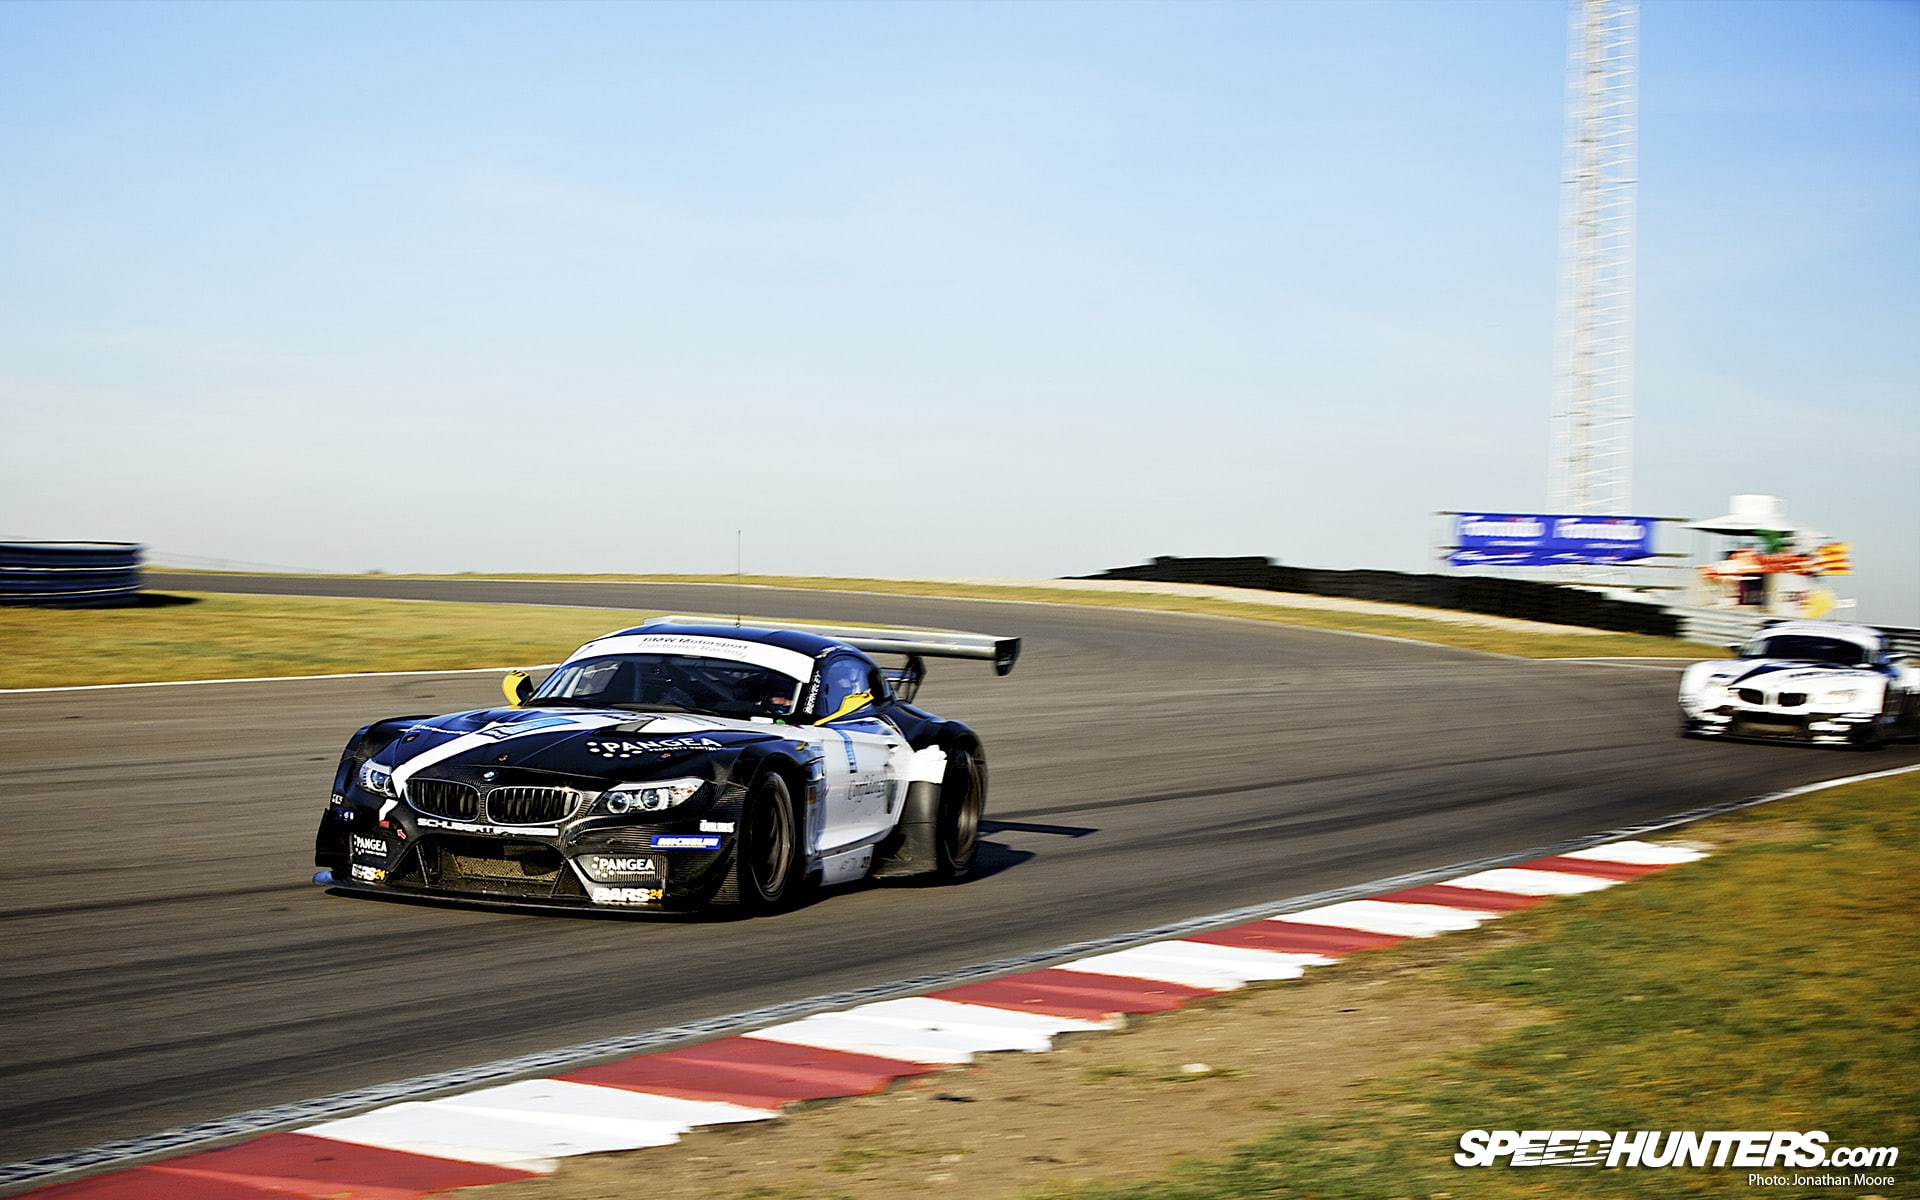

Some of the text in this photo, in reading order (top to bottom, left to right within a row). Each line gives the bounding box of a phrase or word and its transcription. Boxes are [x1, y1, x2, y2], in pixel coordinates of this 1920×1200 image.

[678, 637, 748, 650] Motorsport
[699, 645, 747, 659] Racing
[601, 738, 722, 753] PANGEA
[417, 818, 493, 834] SCHUBERT
[356, 836, 388, 853] PANGEA
[657, 838, 719, 847] MICHELIN
[599, 858, 656, 870] PANGEA
